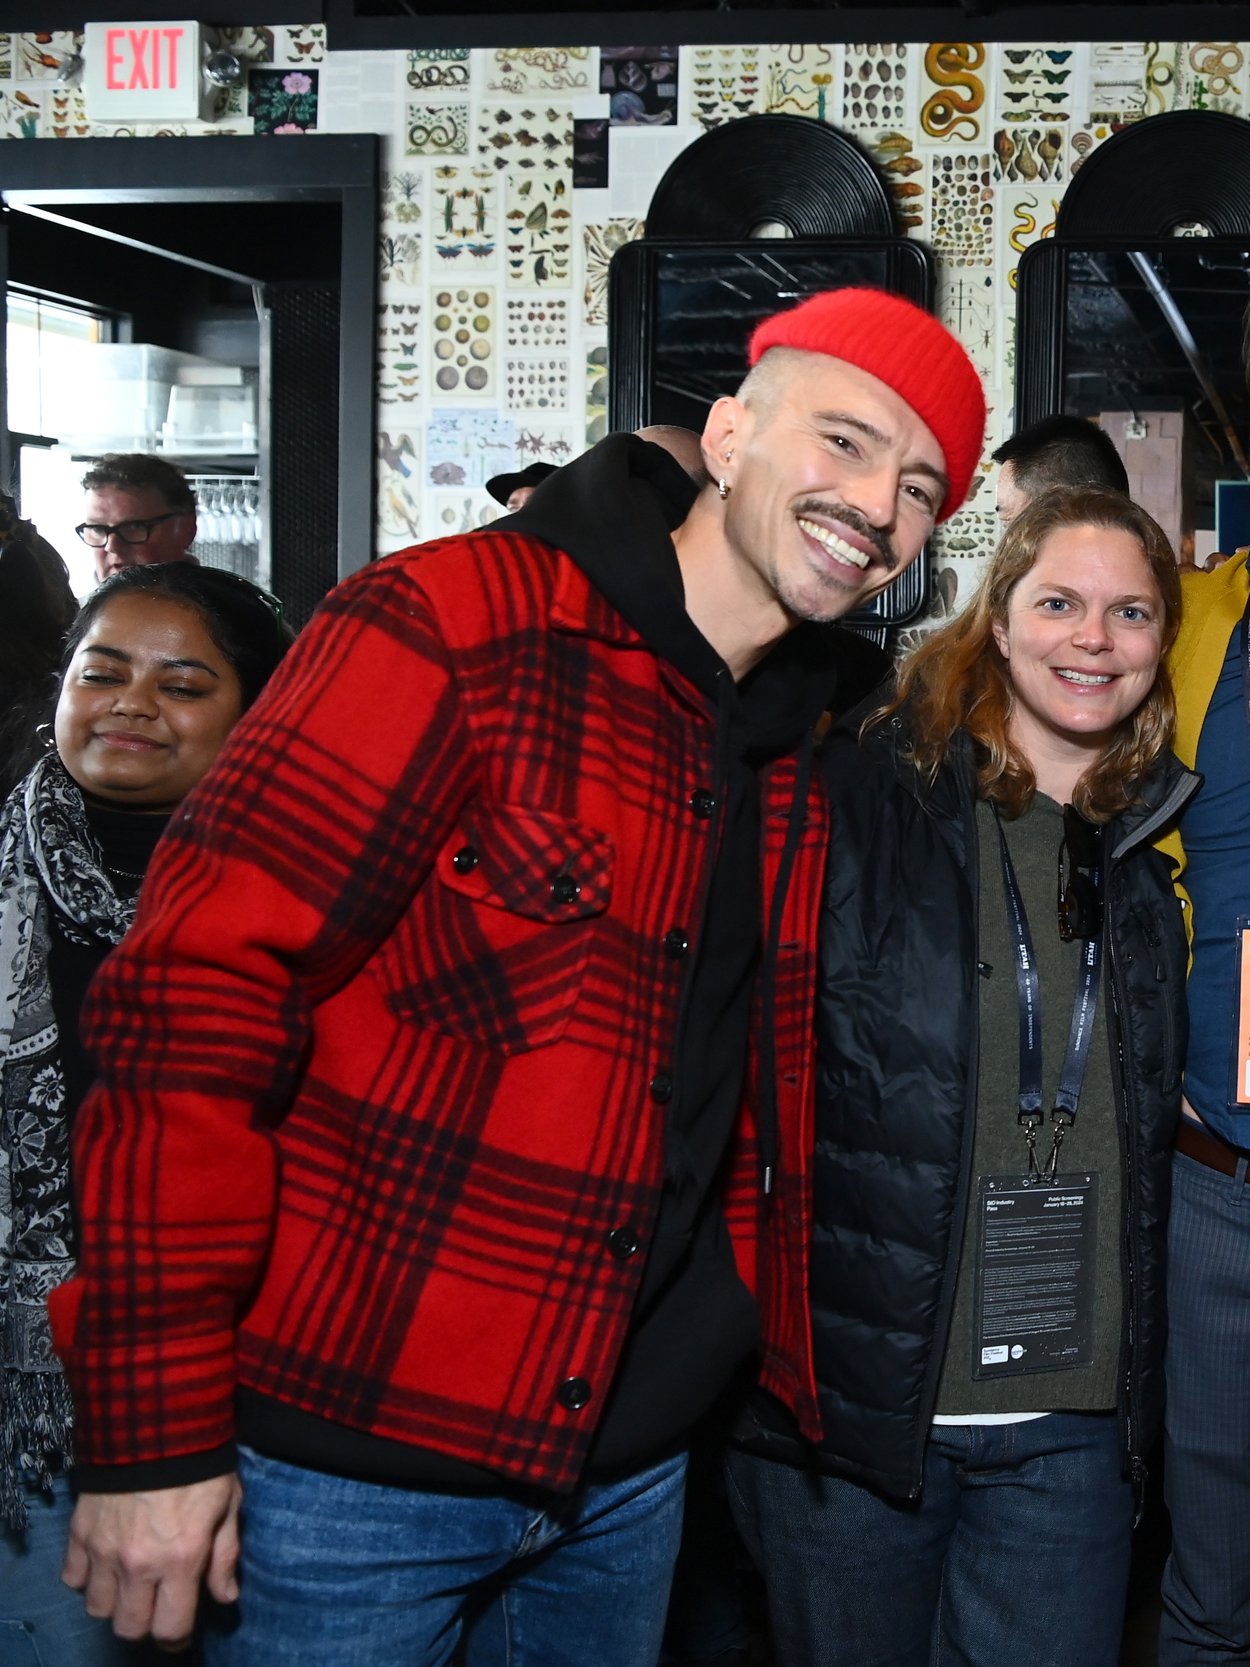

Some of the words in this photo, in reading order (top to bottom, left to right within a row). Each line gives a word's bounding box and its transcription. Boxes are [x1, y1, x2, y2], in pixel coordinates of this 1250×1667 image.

[106, 28, 184, 90] EXIT
[1019, 944, 1030, 970] UTAH
[1075, 1027, 1083, 1051] SUNDANCE
[1081, 988, 1090, 1012] FESTIVAL
[1087, 941, 1096, 967] UTAH
